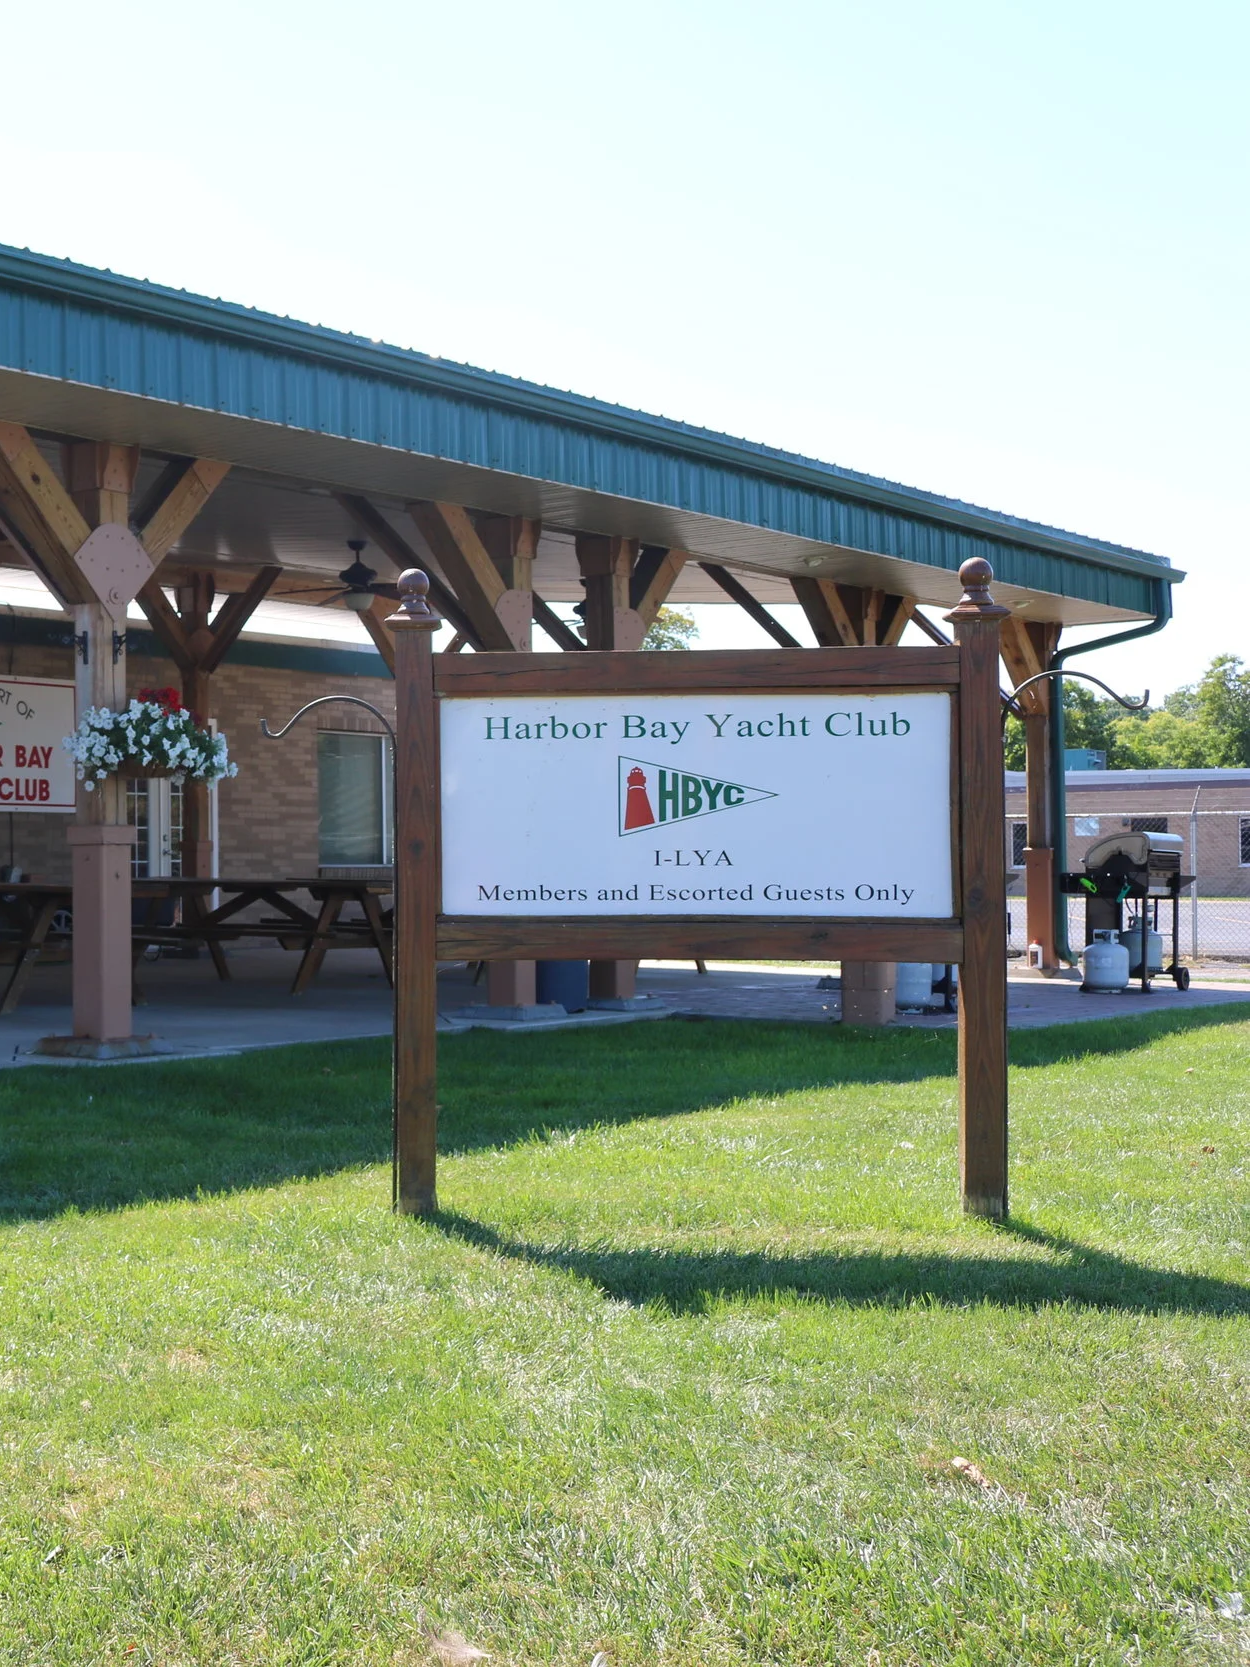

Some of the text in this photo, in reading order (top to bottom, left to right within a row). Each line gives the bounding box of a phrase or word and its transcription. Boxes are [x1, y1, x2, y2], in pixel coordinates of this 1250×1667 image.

[16, 701, 35, 720] OF
[483, 711, 911, 745] Harbor Bay Yacht Club
[15, 745, 53, 769] BAY
[658, 769, 746, 822] HBYC
[653, 849, 734, 867] I-LYA
[477, 883, 915, 905] Members and Escorted Guests Only
